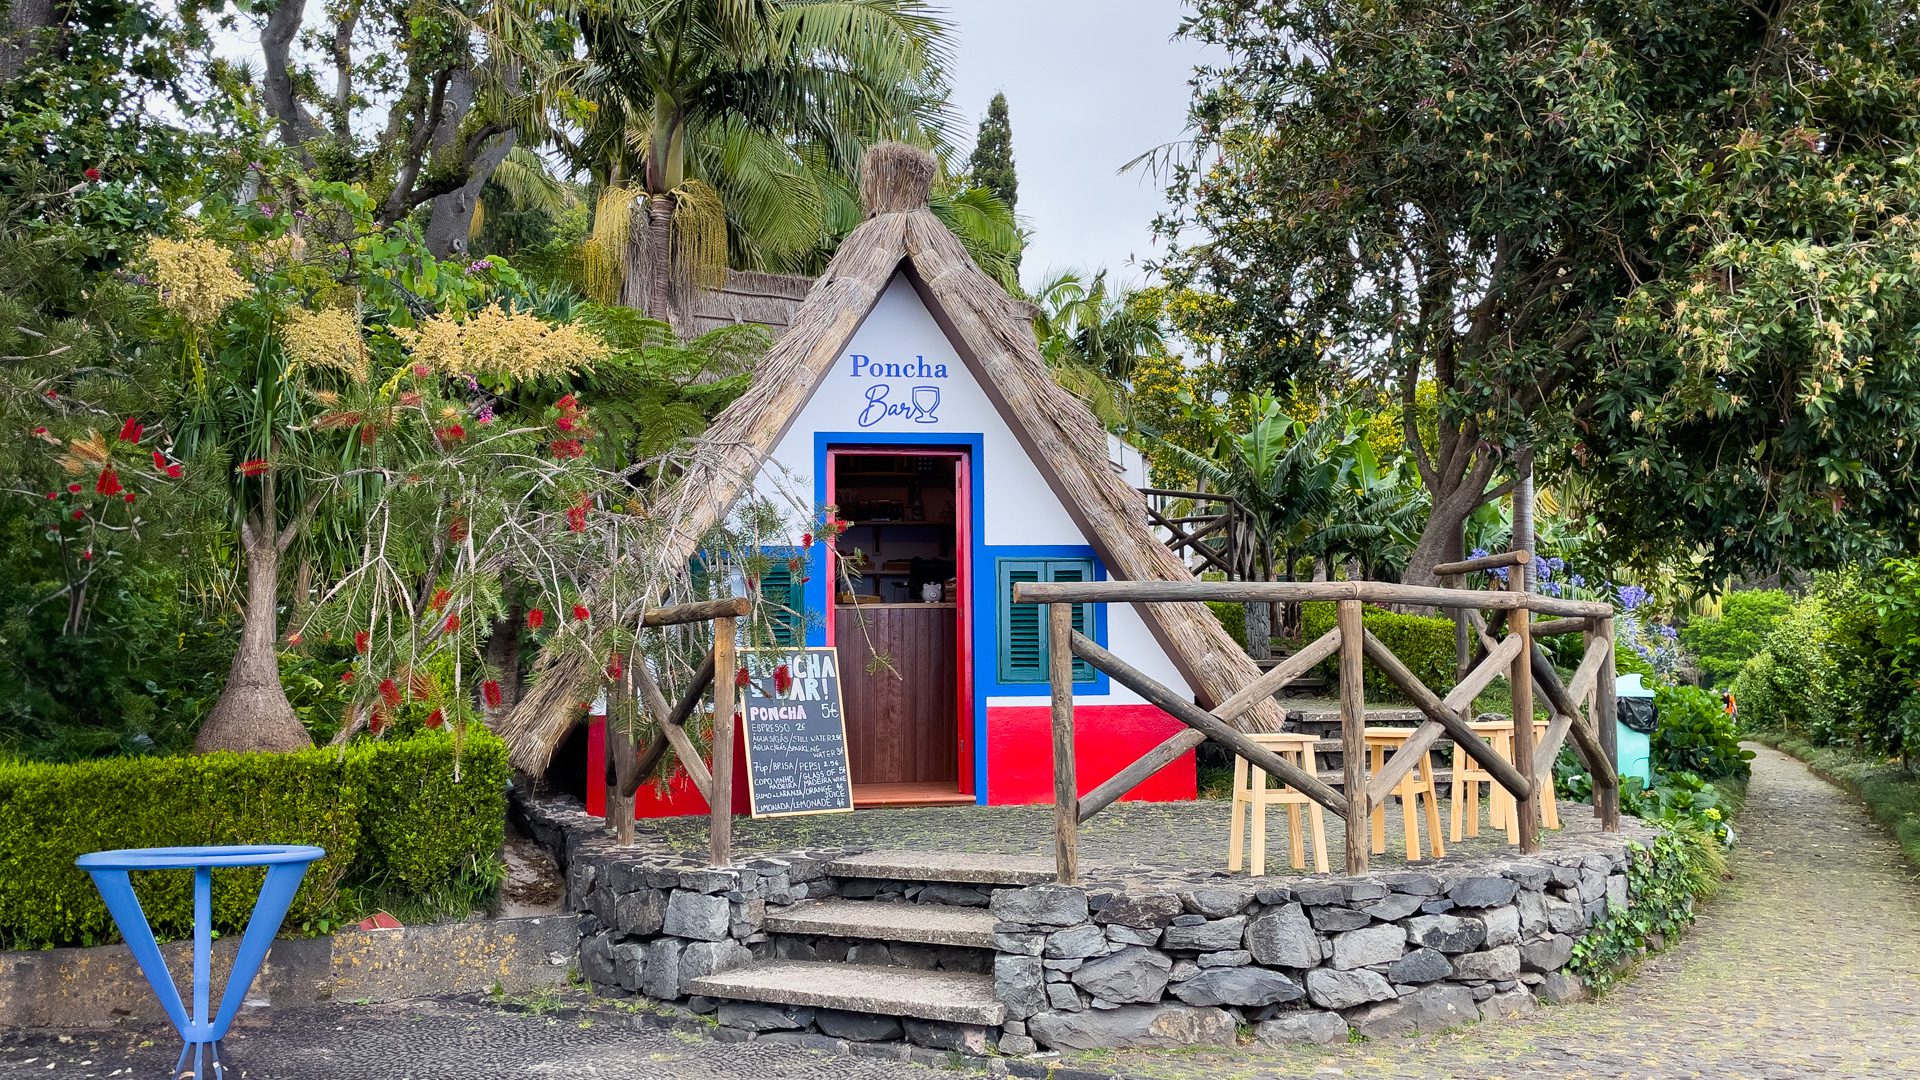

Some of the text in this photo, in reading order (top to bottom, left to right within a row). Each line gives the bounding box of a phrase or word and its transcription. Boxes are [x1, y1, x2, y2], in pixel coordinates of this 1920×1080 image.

[849, 354, 949, 378] Poncha
[858, 384, 917, 427] Bar
[775, 677, 829, 701] AR!
[750, 702, 839, 721] PONCHA 5€
[751, 722, 806, 733] ESPRESSO 2€
[812, 746, 845, 759] WATER 3€
[773, 775, 795, 784] VINHO
[826, 768, 836, 777] OF
[803, 776, 833, 786] MADEIRA
[832, 775, 847, 783] WINE
[755, 792, 772, 800] SUMO
[825, 790, 846, 799] JUICE
